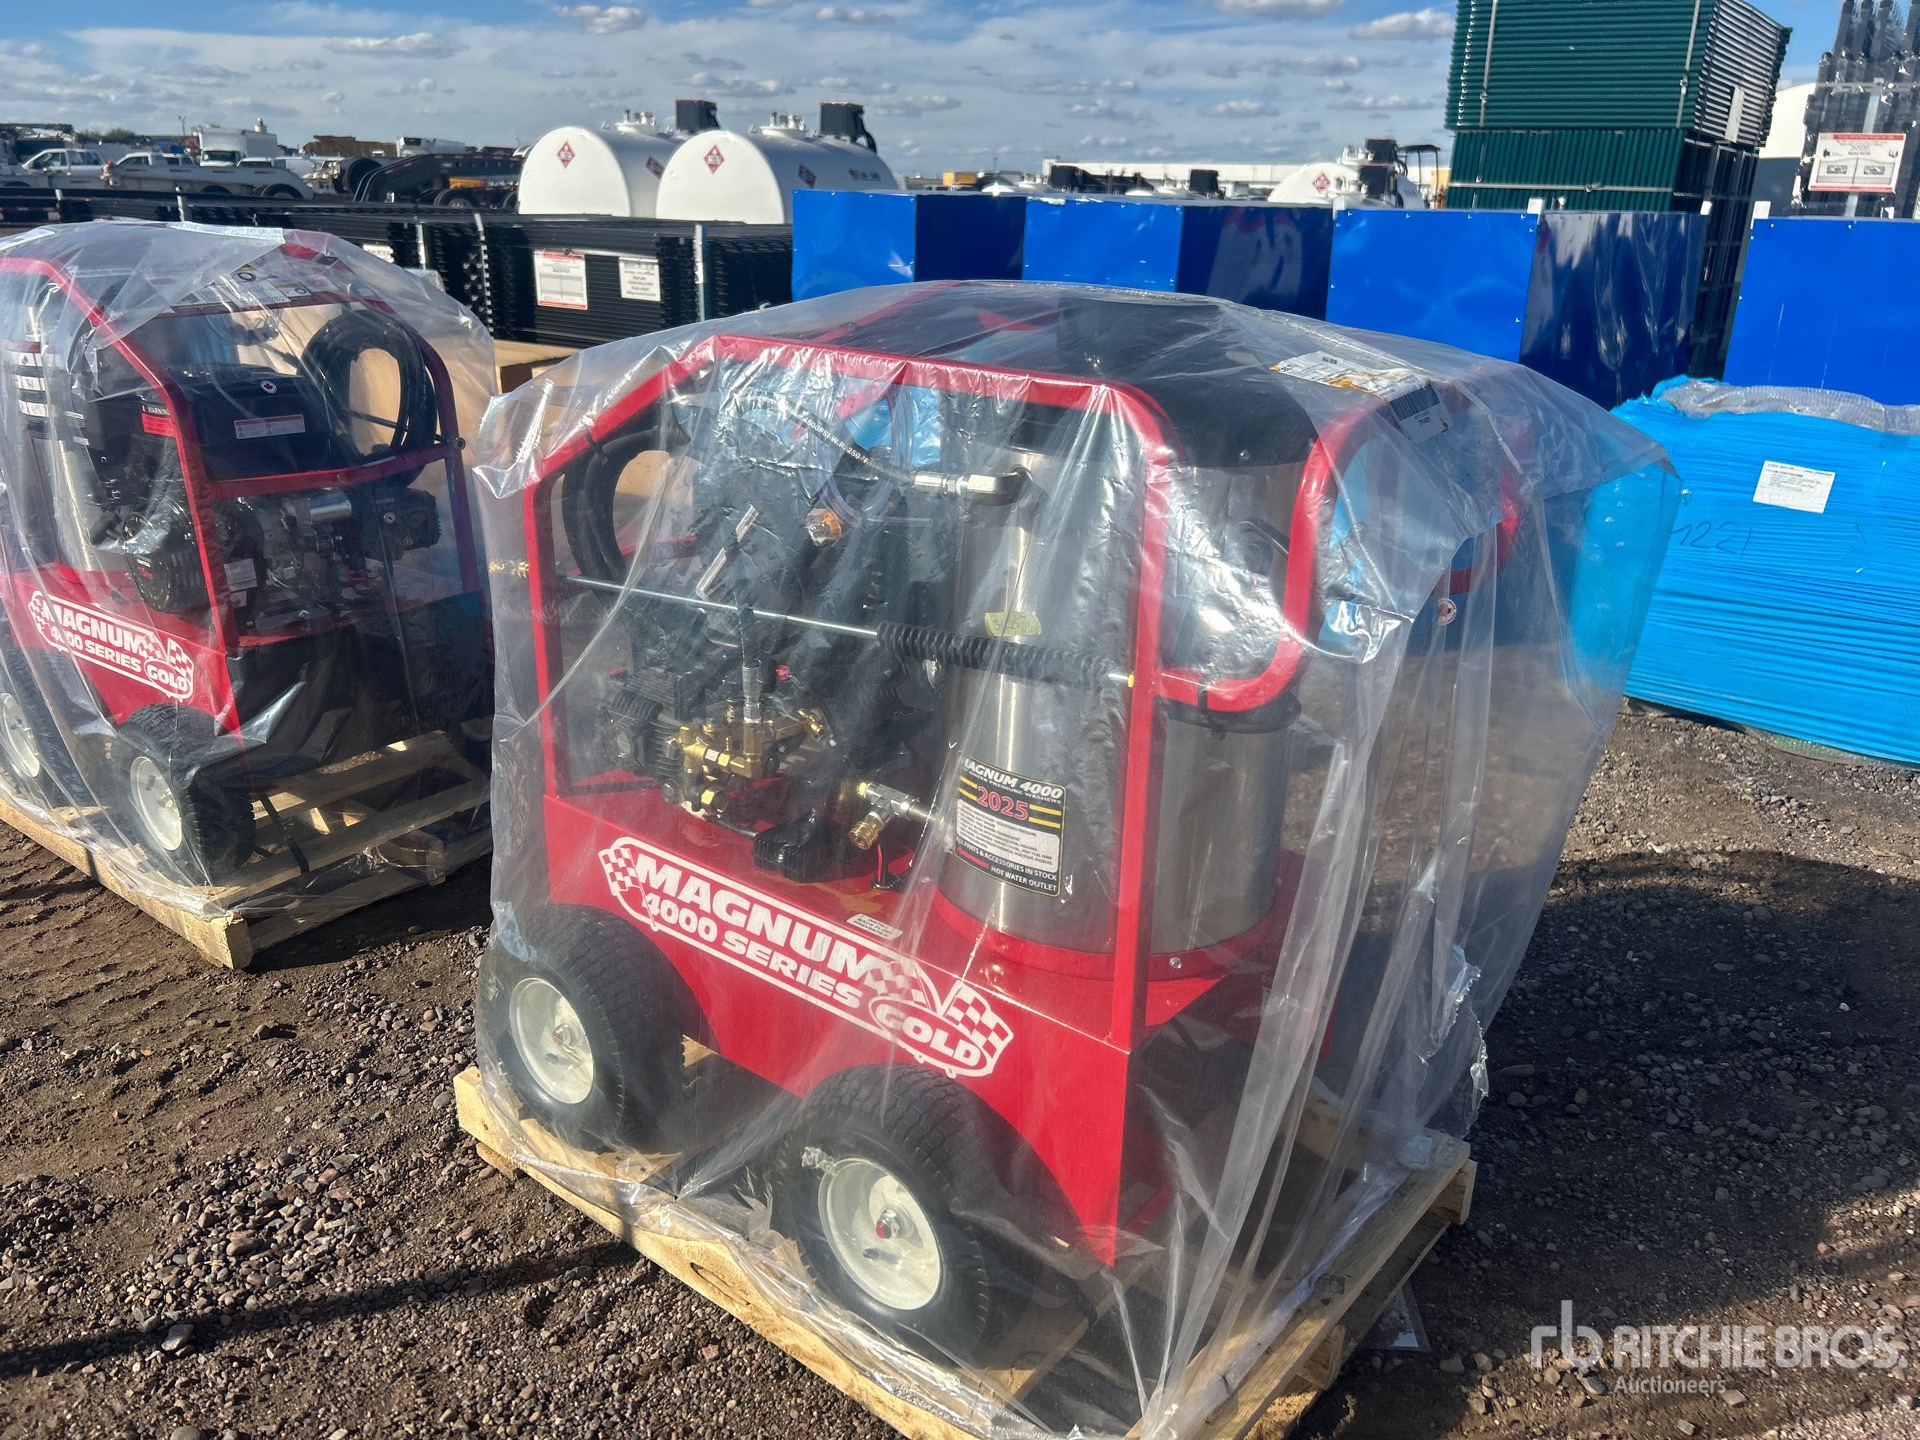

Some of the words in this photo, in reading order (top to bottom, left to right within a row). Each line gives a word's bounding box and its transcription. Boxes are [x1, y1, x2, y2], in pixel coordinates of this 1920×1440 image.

[846, 447, 861, 459] 250
[42, 600, 146, 655] MAGNUM
[84, 640, 142, 673] SERIES
[146, 664, 188, 692] GOLD
[977, 786, 1029, 821] 2025
[989, 780, 1023, 796] PRESSURE
[1024, 791, 1062, 805] WASHERS
[1019, 781, 1064, 799] 4000
[964, 843, 979, 854] PARTS
[984, 853, 1025, 873] ACCESSORIES
[1025, 867, 1033, 875] IN
[1034, 870, 1057, 881] STOCK
[991, 865, 1005, 876] HOT
[1005, 871, 1028, 884] WATER
[1028, 879, 1057, 892] OUTLET
[635, 853, 892, 986] MAGNUM
[857, 917, 874, 927] BACK
[641, 892, 718, 943] 4000
[722, 930, 863, 1009] SERIES
[875, 1003, 982, 1067] GOLD
